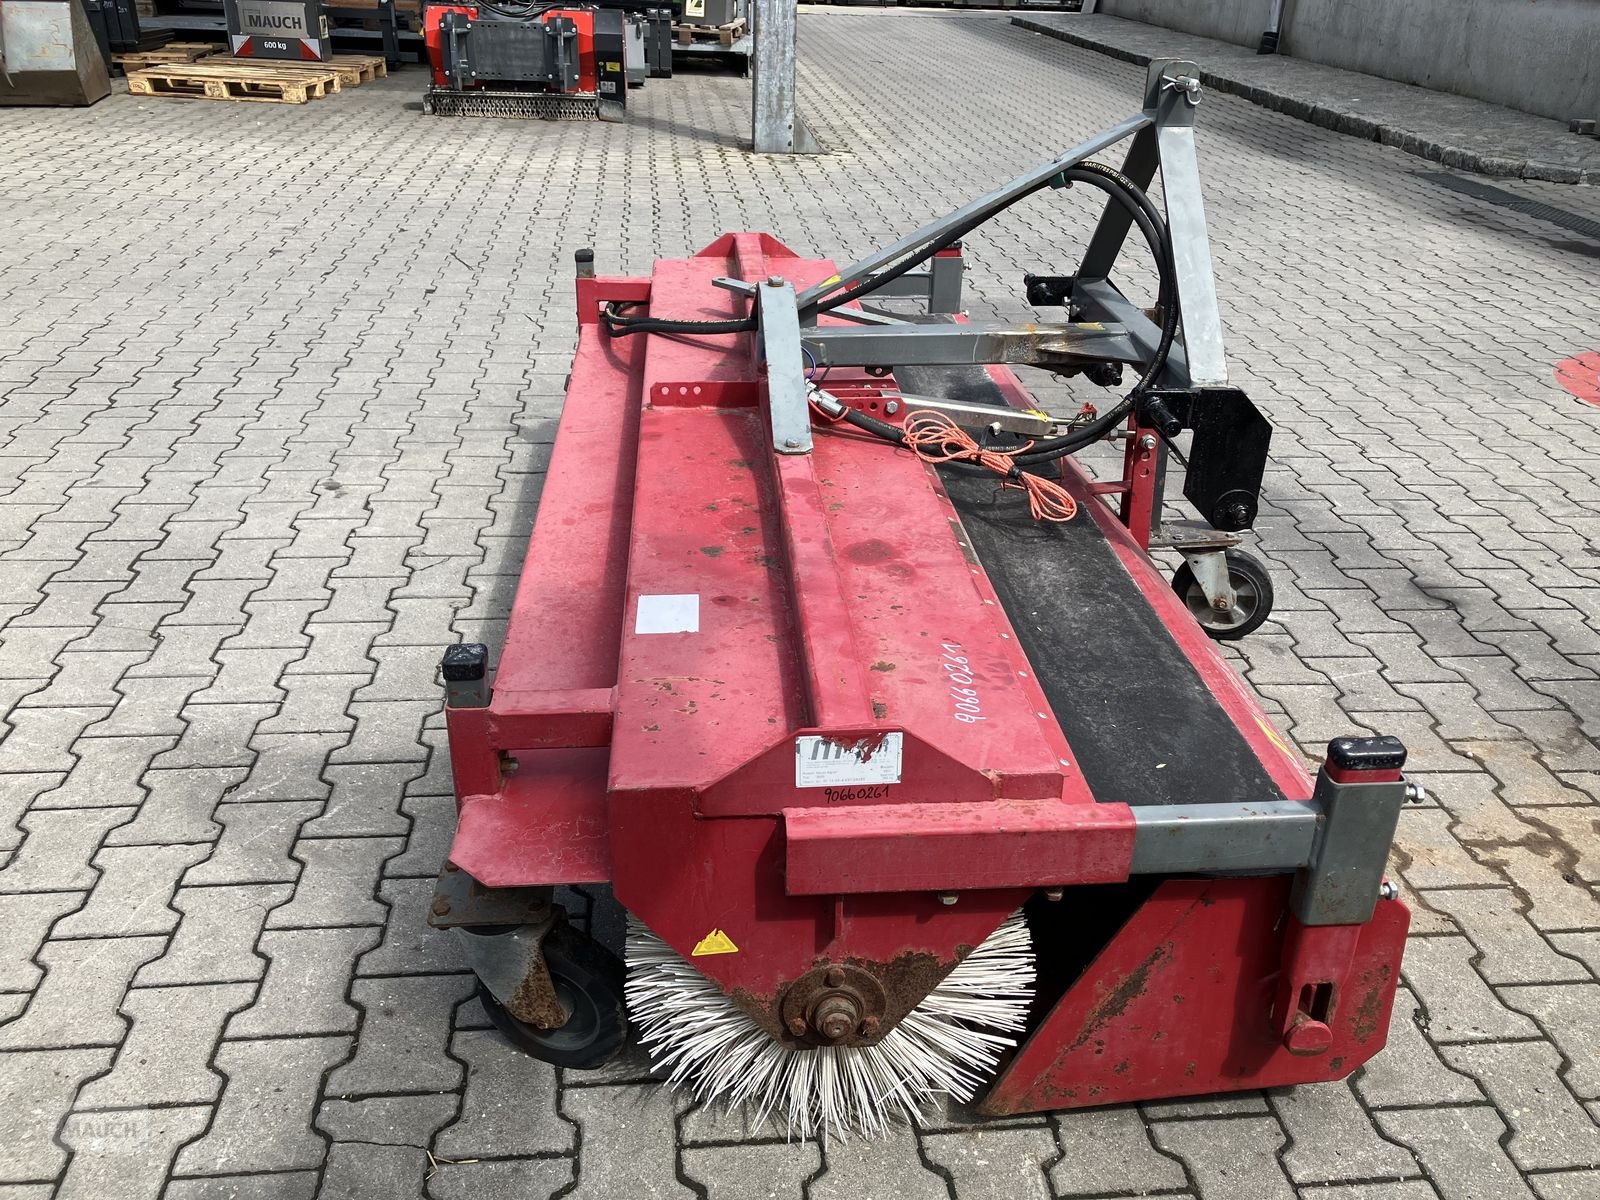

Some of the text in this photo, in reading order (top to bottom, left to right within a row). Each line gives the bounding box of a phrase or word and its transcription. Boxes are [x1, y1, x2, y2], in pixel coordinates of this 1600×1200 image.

[247, 15, 302, 29] MAUCH
[264, 41, 287, 50] 600 kg
[941, 643, 987, 723] 90660261
[824, 785, 889, 804] 90660261
